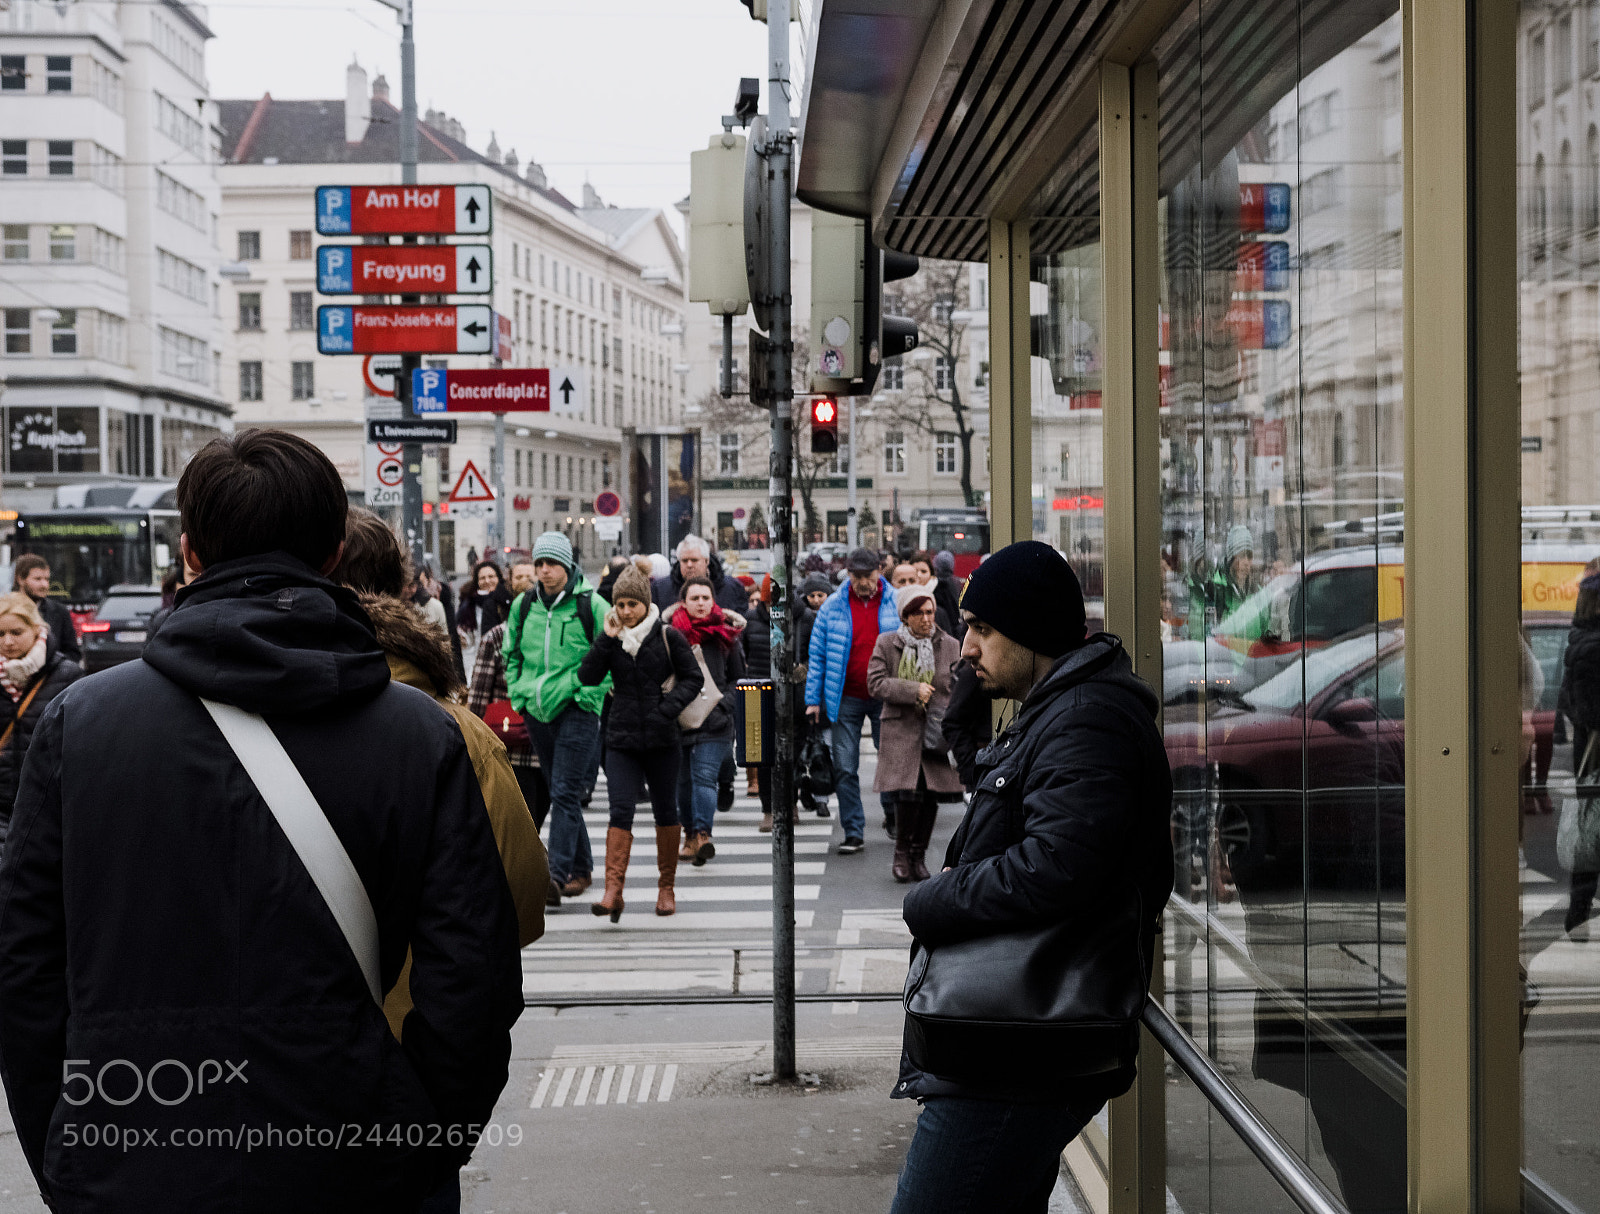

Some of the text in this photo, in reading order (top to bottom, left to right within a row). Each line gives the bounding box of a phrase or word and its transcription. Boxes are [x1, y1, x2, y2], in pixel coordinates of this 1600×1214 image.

[326, 196, 342, 215] P
[365, 189, 440, 208] Am Hof
[327, 256, 343, 275] P
[363, 260, 446, 282] Freyung
[328, 315, 344, 334] P
[354, 312, 455, 327] Franz-Josefs-Kai
[423, 377, 439, 396] P
[450, 382, 547, 403] Concordiaplatz
[373, 487, 400, 502] Zon
